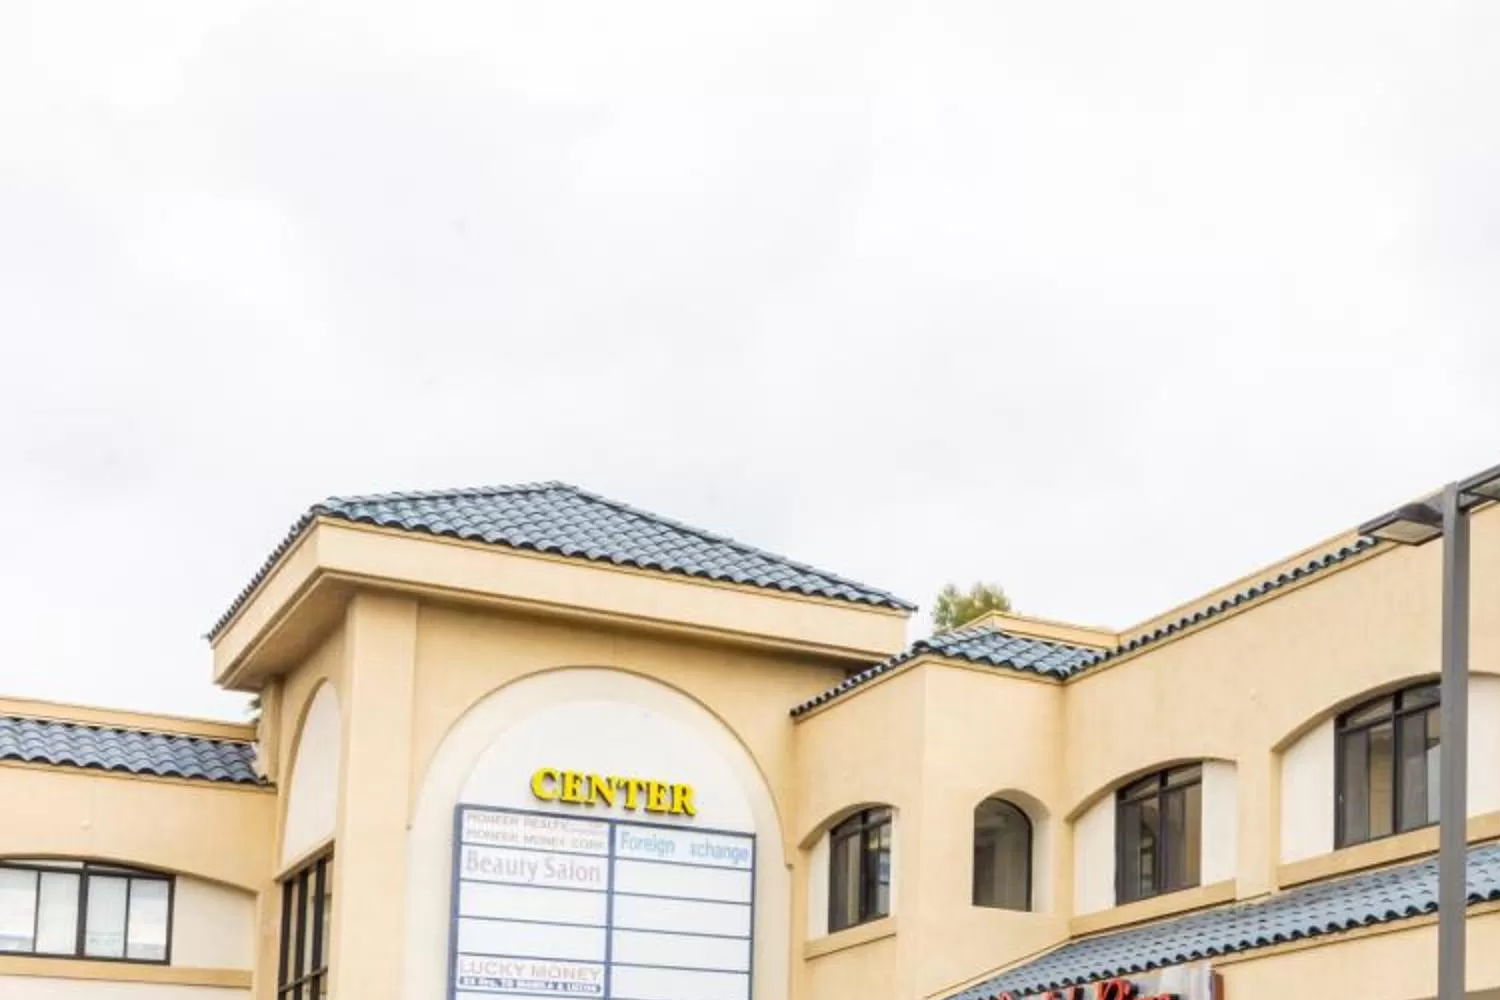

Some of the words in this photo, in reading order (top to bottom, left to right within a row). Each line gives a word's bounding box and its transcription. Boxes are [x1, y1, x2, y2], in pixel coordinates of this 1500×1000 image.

[531, 767, 697, 816] CENTER
[620, 831, 676, 857] Foreign
[466, 849, 539, 882] Beauty
[543, 855, 602, 882] Salon
[462, 959, 523, 977] LUCKY
[531, 963, 601, 982] MONEY
